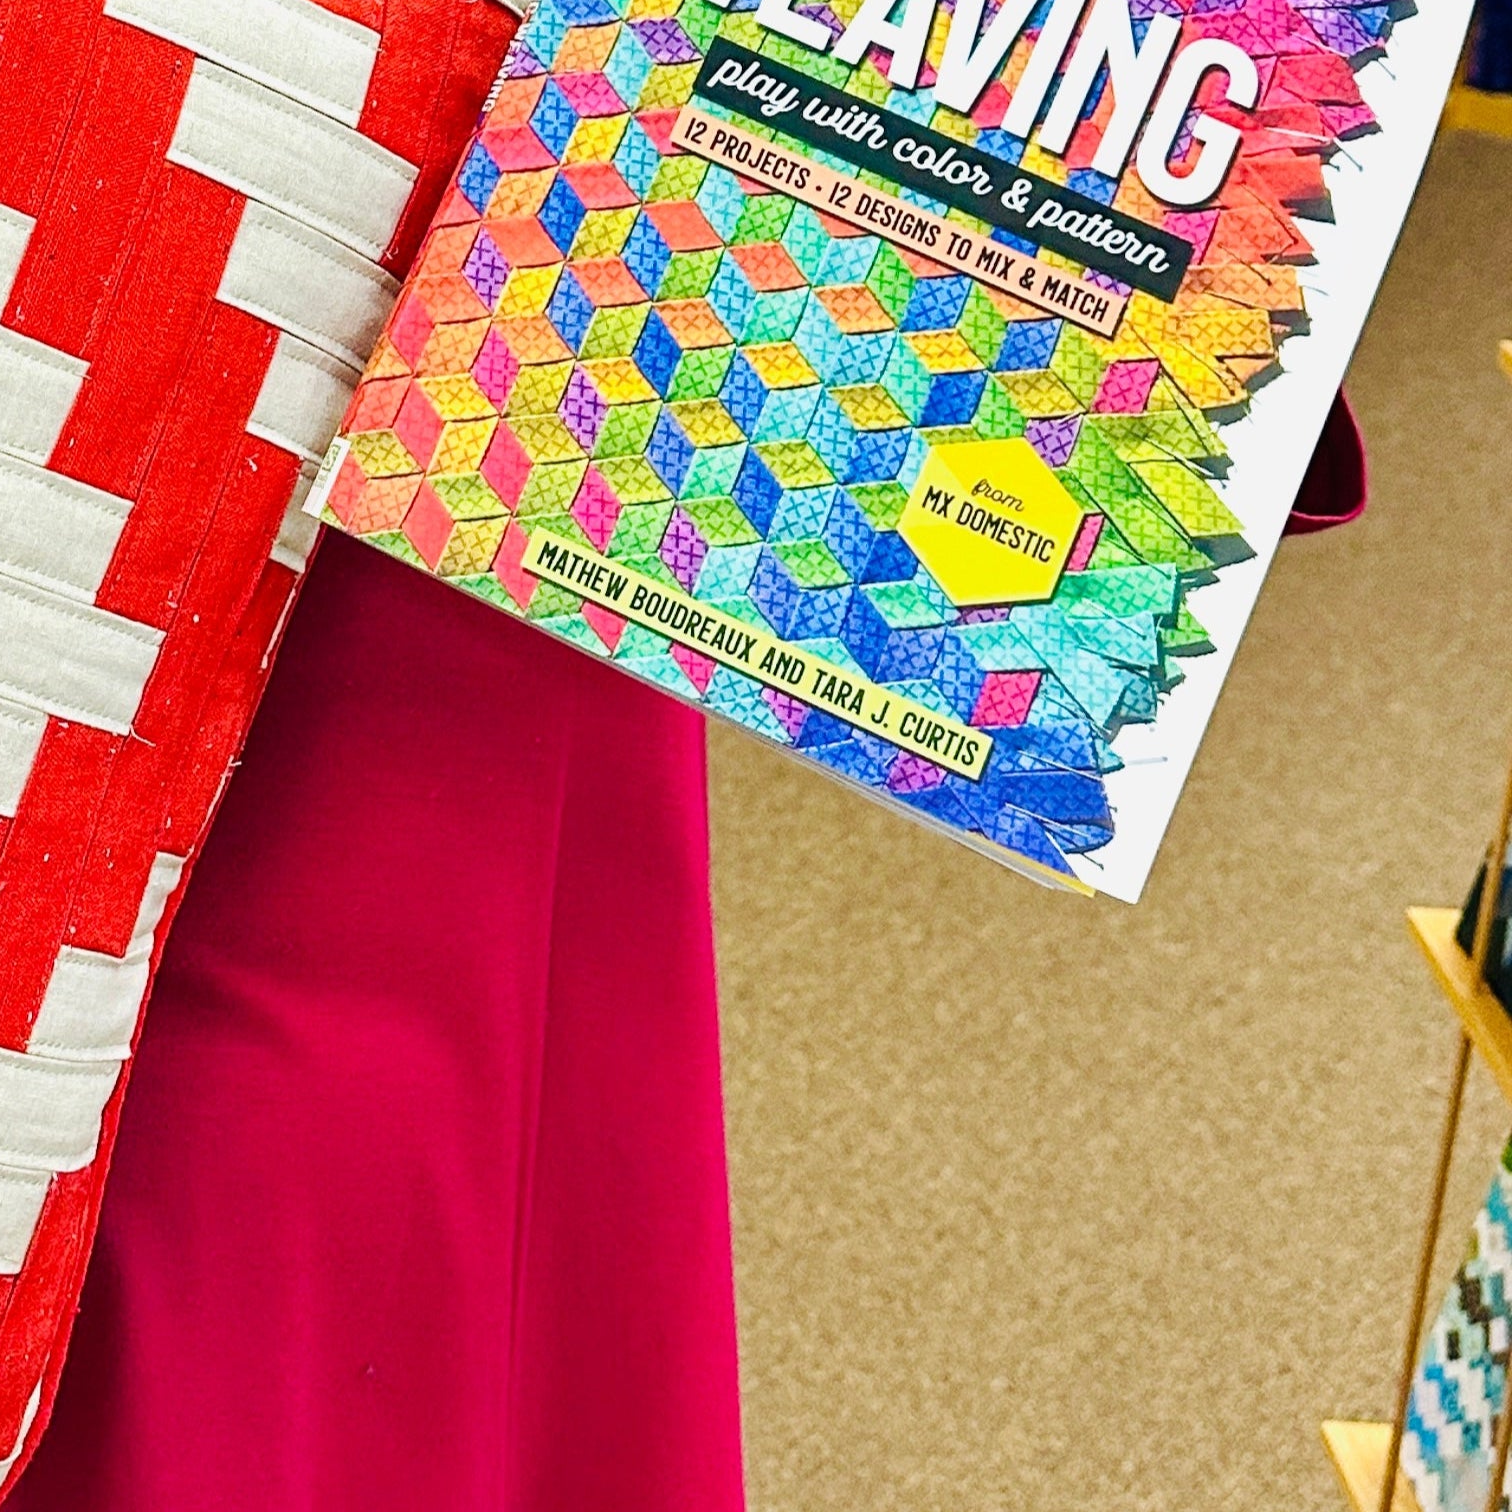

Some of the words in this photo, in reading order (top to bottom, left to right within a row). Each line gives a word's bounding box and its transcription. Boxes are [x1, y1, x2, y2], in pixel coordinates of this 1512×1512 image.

[684, 117, 707, 145] 12
[709, 129, 811, 190] PROJECTS
[828, 182, 851, 209] 12
[855, 193, 941, 247] DESIGNS
[946, 232, 972, 261] TO
[975, 246, 1016, 280] MIX
[1019, 267, 1036, 291] &
[1041, 275, 1110, 324] MATCH
[707, 58, 799, 117] play
[803, 97, 888, 150] with
[892, 137, 993, 196] color
[1001, 179, 1032, 213] &
[1026, 198, 1170, 274] pattern
[922, 485, 955, 518] MX
[956, 502, 1056, 563] DOMESTIC
[971, 478, 1025, 512] from
[536, 541, 628, 602] MATHEW
[629, 584, 758, 663] BOUDREAUX
[758, 646, 806, 686] AND
[810, 668, 866, 715] TARA
[871, 700, 888, 728] J.
[899, 711, 980, 766] CURTIS
